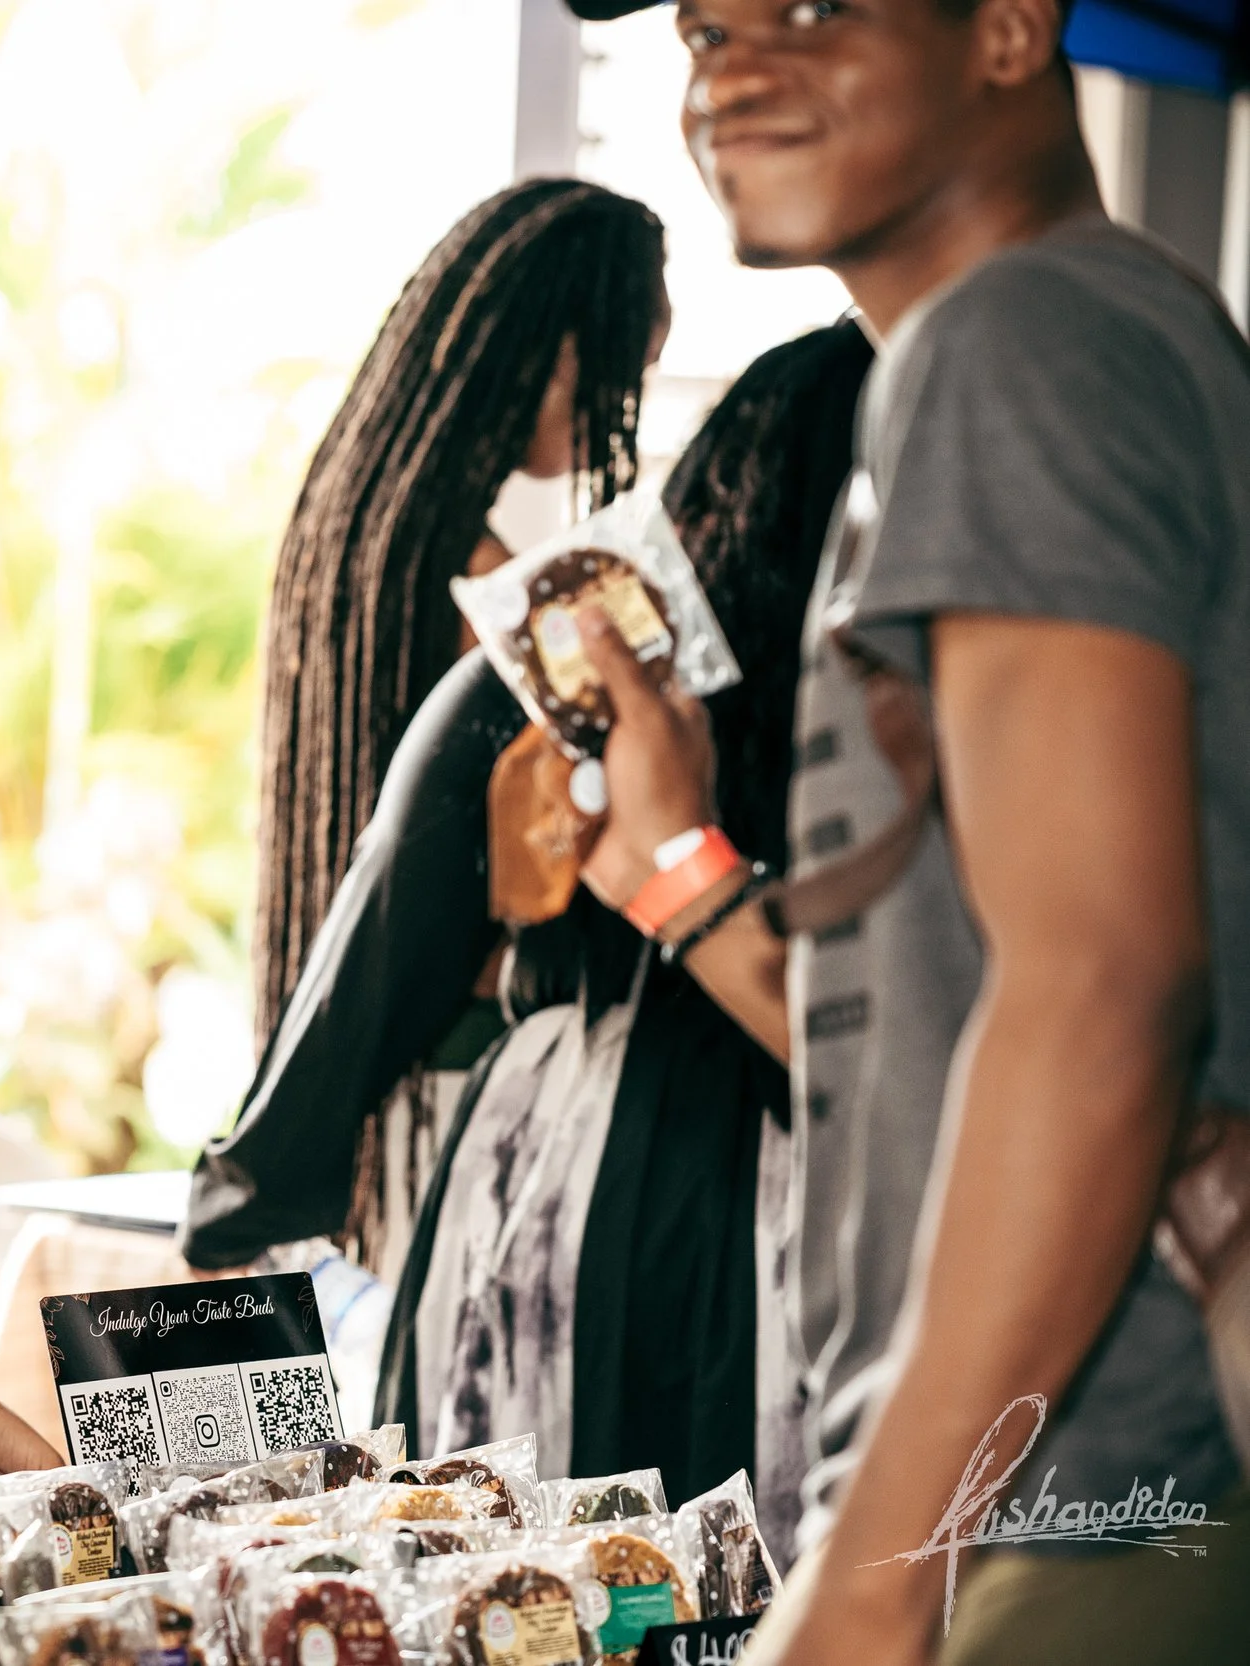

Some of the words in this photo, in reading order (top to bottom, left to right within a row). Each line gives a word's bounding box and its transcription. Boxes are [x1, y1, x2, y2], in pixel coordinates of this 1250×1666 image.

[89, 1306, 149, 1338] Indulge
[149, 1300, 190, 1337] Your
[192, 1299, 233, 1325] Taste
[234, 1293, 275, 1319] Buds
